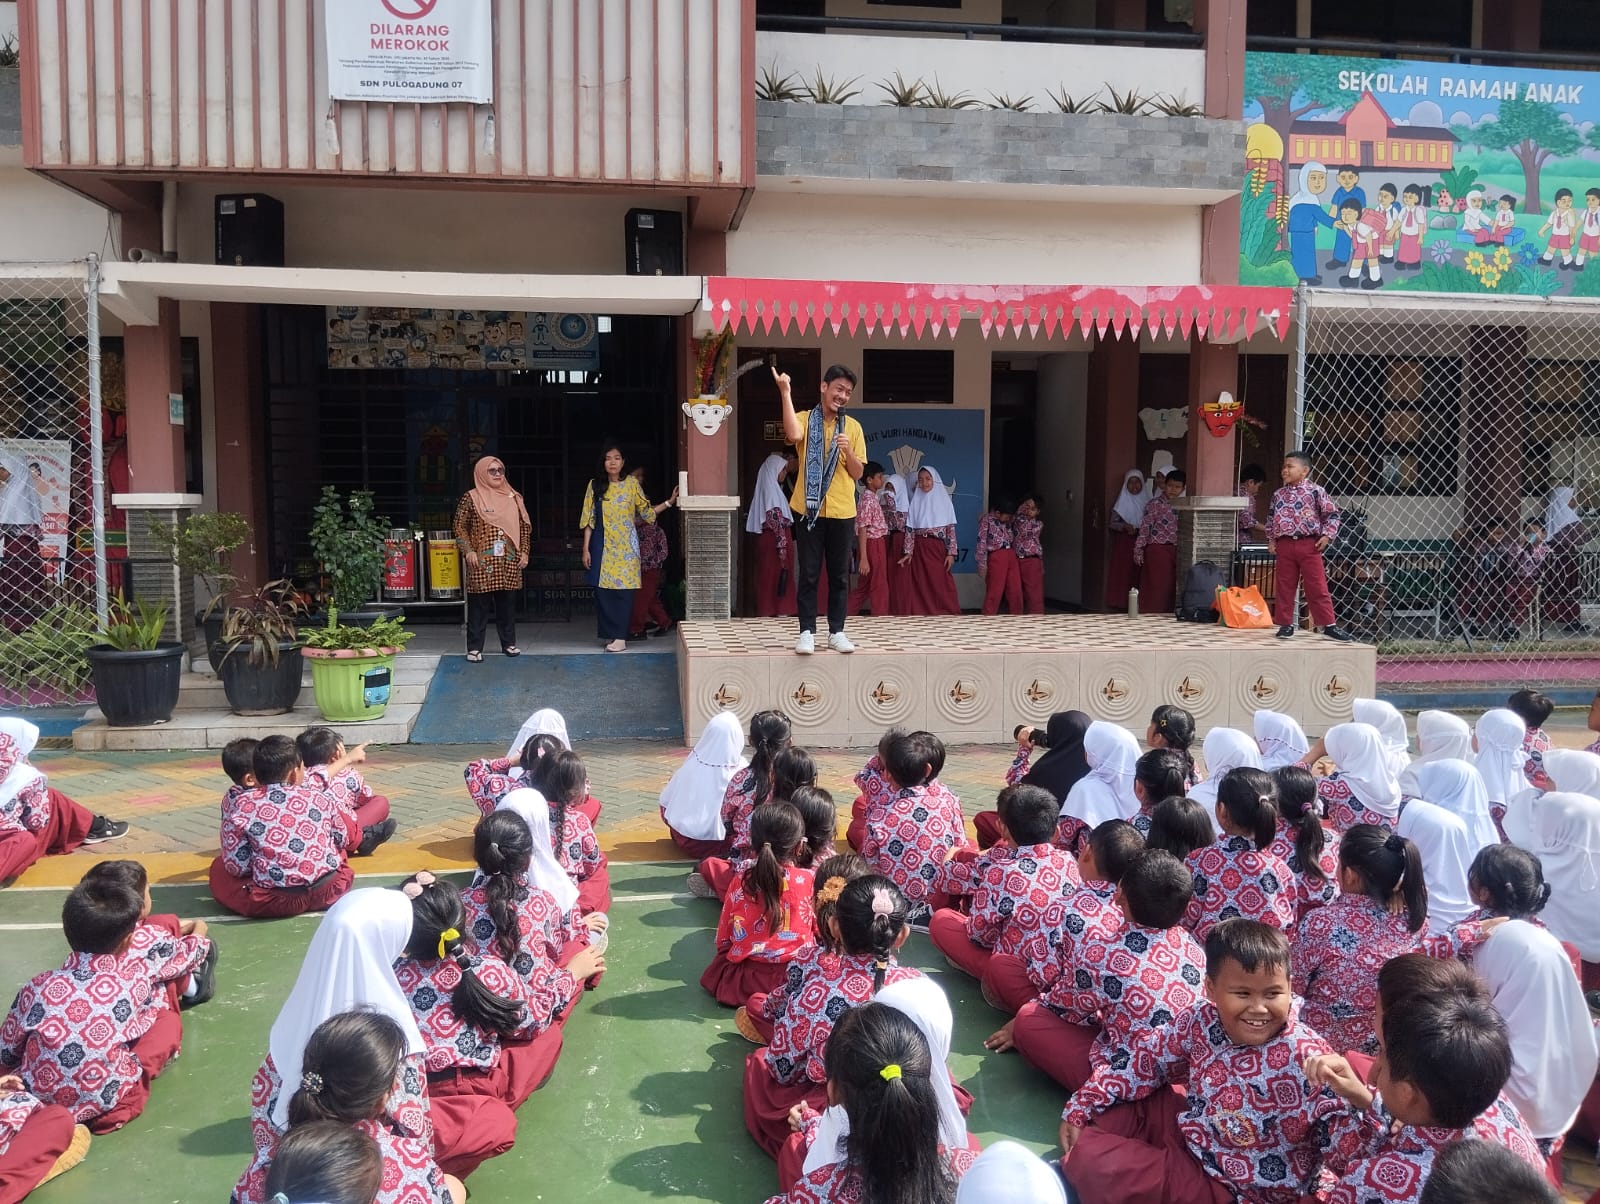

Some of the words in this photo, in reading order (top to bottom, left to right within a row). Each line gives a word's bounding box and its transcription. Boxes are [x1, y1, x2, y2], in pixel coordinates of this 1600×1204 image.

[370, 23, 449, 36] DILARANG
[370, 38, 449, 51] MEROKOK
[383, 81, 449, 89] PULOGADUNG
[1338, 70, 1428, 96] SEKOLAH
[1440, 77, 1517, 101] RAMAH
[1525, 82, 1584, 105] ANAK
[902, 428, 945, 444] HANDAYANI
